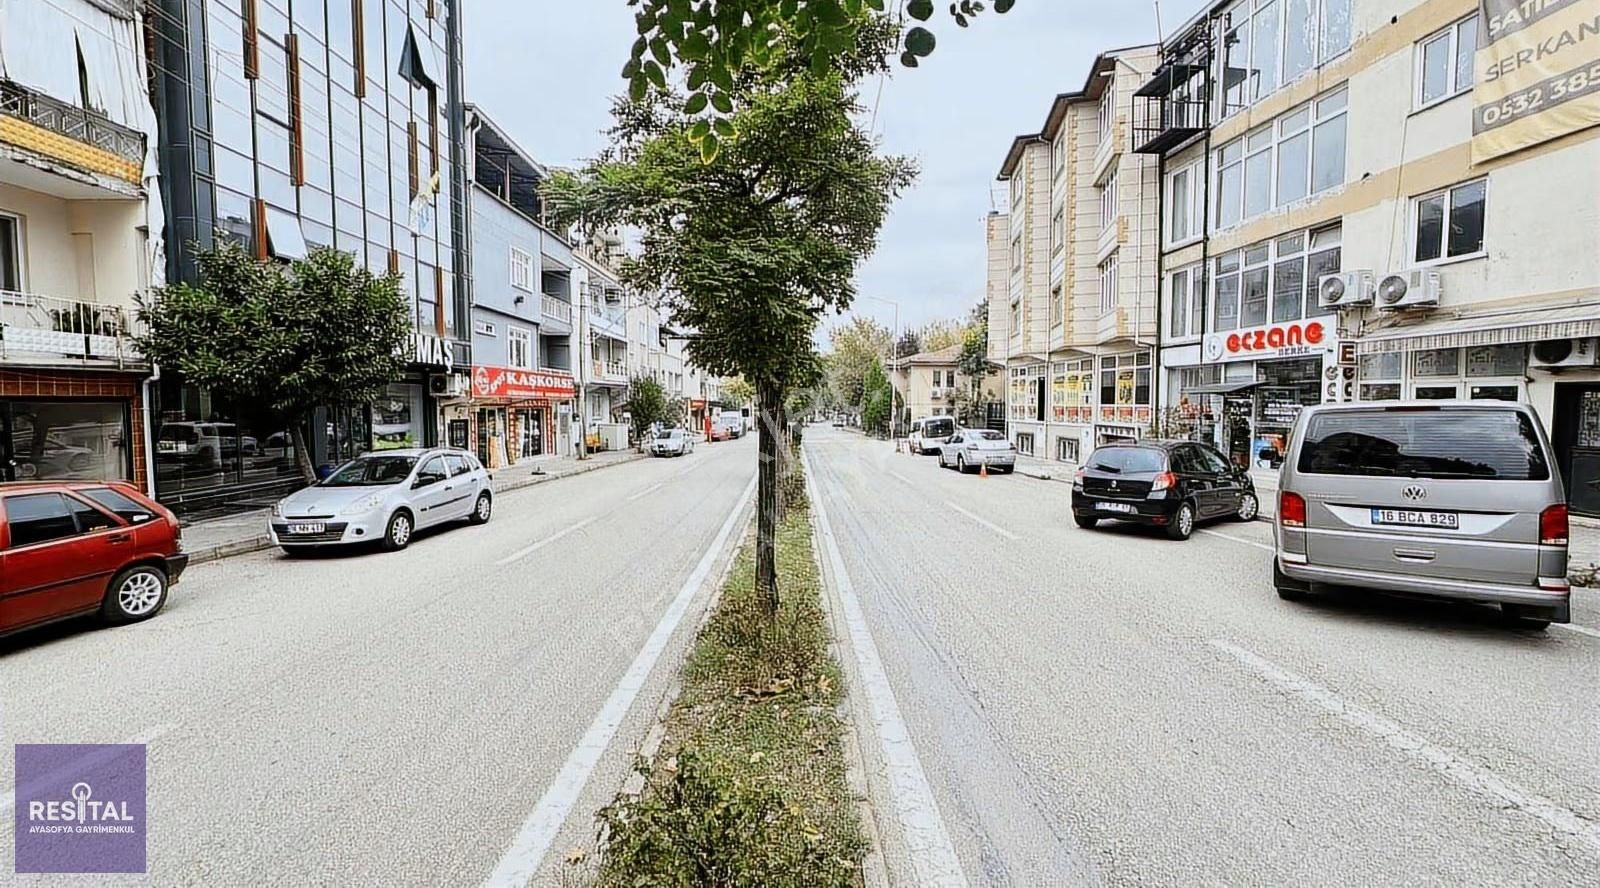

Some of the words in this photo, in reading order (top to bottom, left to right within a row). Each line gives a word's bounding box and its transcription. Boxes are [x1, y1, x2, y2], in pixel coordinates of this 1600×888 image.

[1485, 15, 1600, 82] SERKAN
[1483, 89, 1543, 124] 0532
[506, 372, 574, 389] KAŞKORSE
[1381, 511, 1394, 521] 16
[1398, 511, 1425, 523] BCA
[1430, 514, 1456, 525] 829
